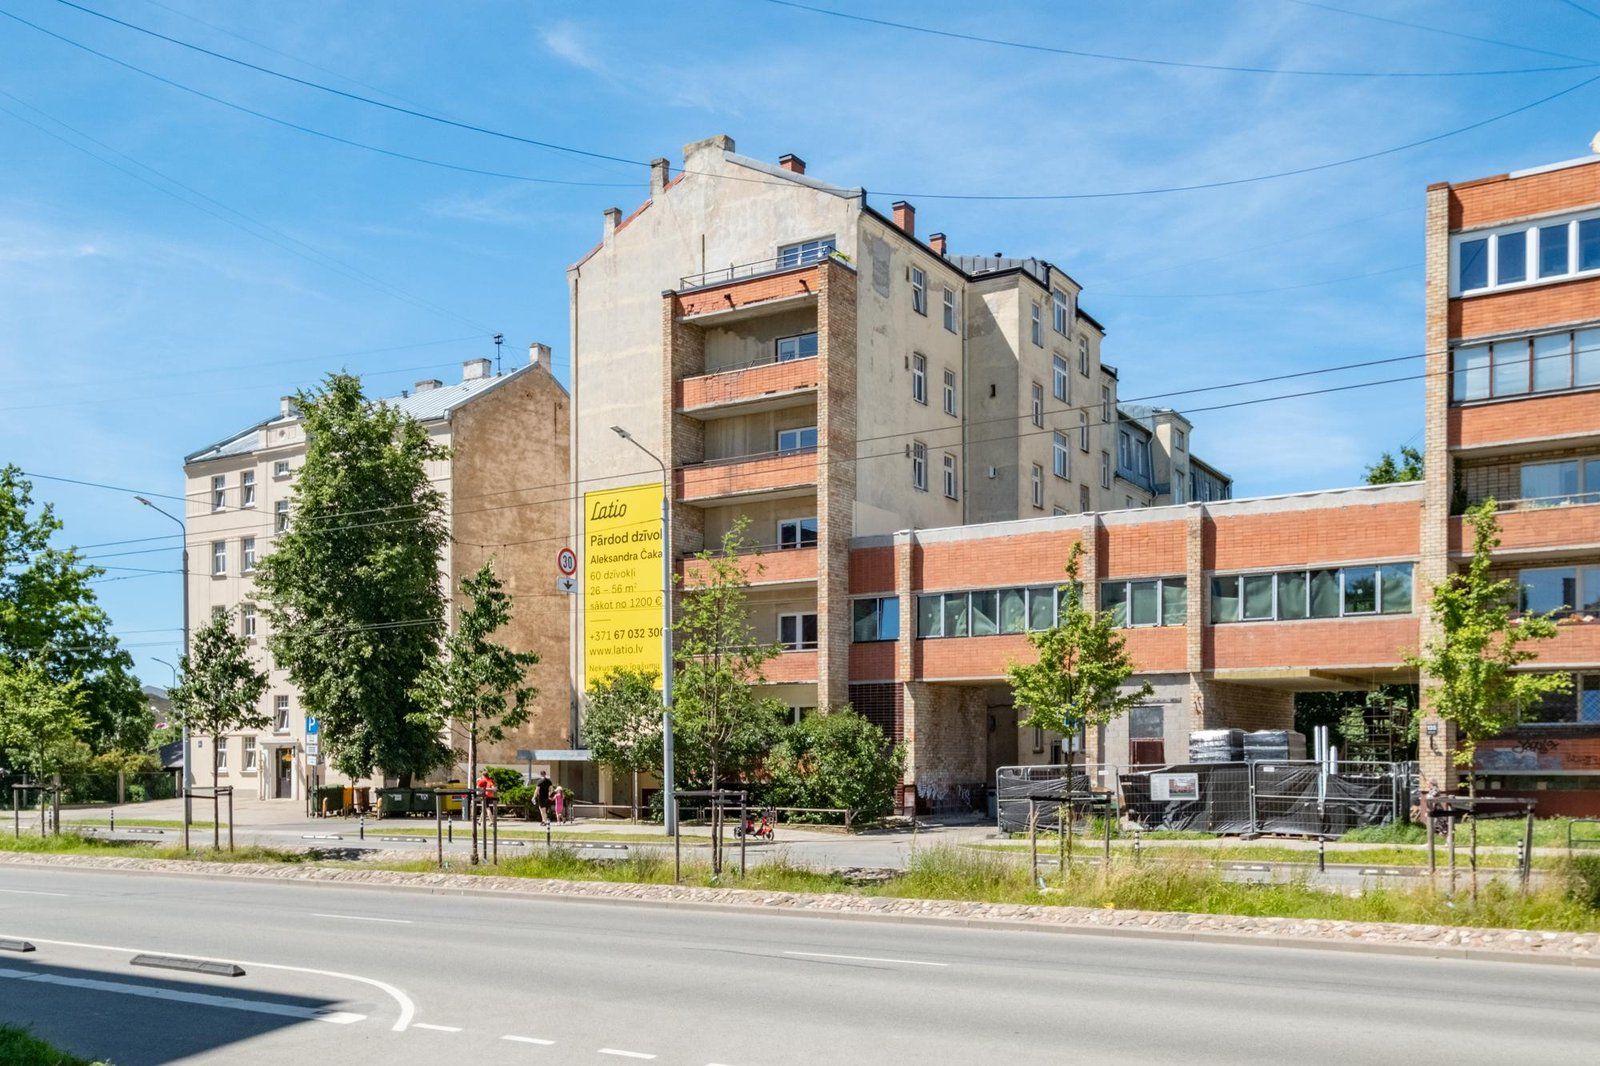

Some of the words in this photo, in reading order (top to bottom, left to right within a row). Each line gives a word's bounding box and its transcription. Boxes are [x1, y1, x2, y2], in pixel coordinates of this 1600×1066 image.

[591, 500, 626, 520] Latio
[590, 532, 628, 546] Pārdod
[562, 554, 572, 570] 30
[590, 552, 638, 564] Aleksandra
[640, 548, 662, 560] Čaka
[590, 571, 602, 580] 60
[590, 586, 600, 596] 26
[612, 584, 622, 594] 56
[590, 600, 612, 610] sākot
[630, 597, 652, 608] 1200
[590, 630, 611, 641] +371
[614, 630, 625, 640] 67
[628, 628, 645, 639] 032
[590, 644, 643, 656] www.latio.lv
[308, 716, 316, 731] P
